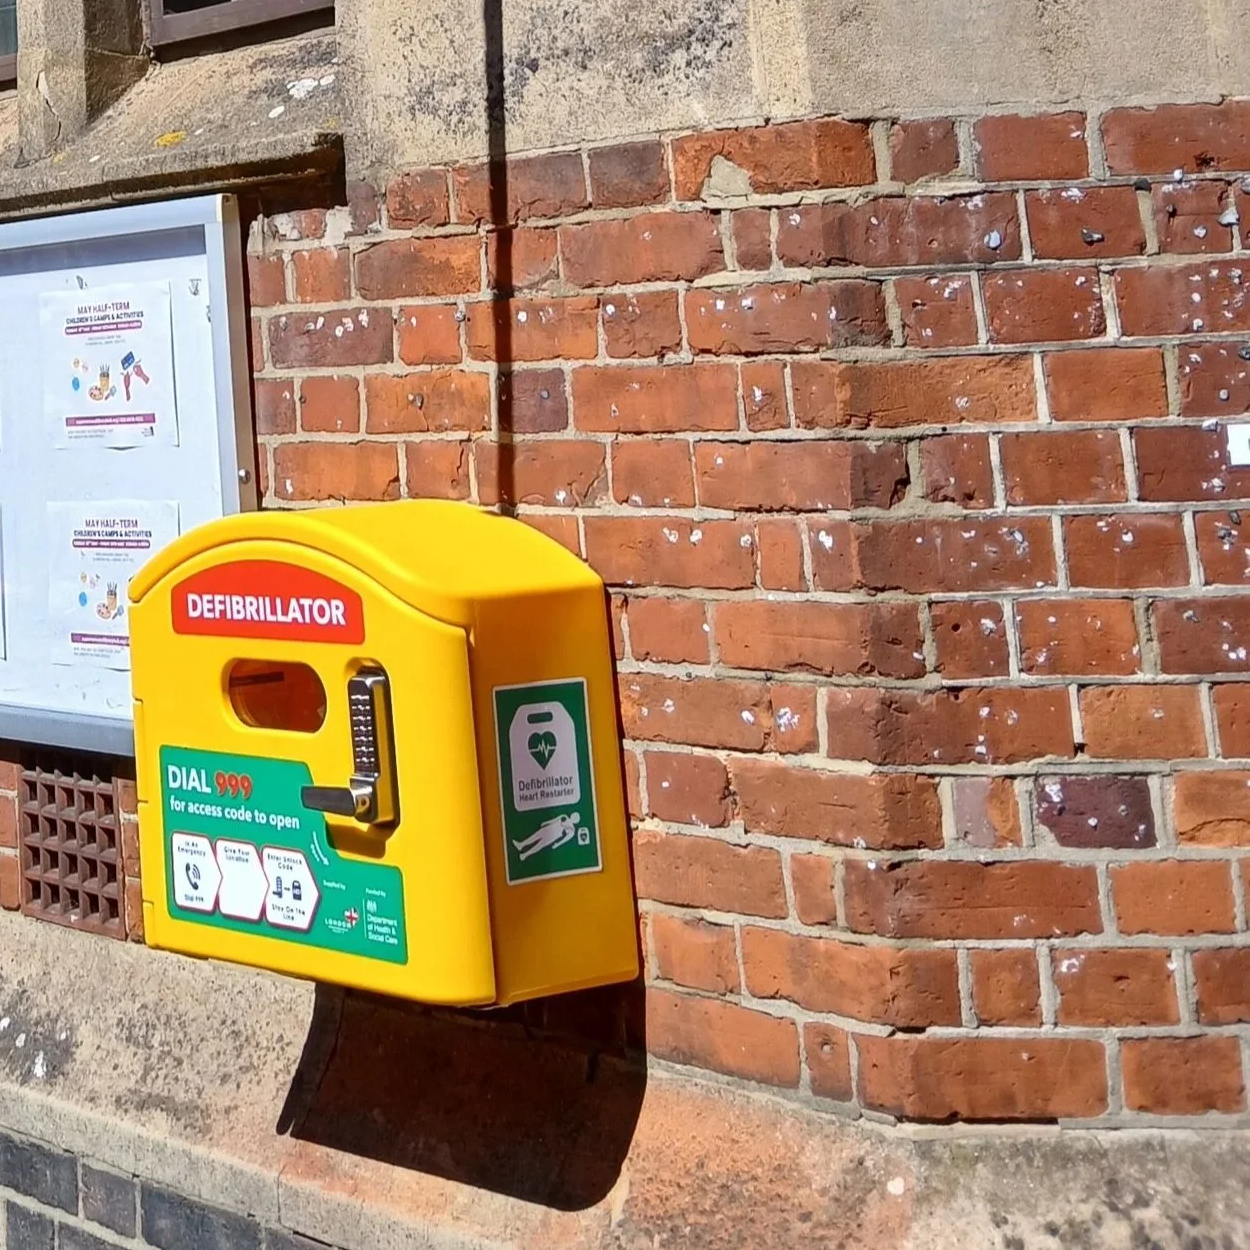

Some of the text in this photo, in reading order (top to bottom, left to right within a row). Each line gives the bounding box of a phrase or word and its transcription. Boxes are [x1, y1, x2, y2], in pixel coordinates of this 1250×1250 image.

[77, 301, 130, 314] MAY HALF-TERM
[85, 519, 138, 528] MAY HALF-TERM
[186, 592, 346, 626] DEFIBRILLATOR
[167, 764, 253, 800] DIAL 999
[518, 775, 573, 792] Defibrillator
[519, 787, 574, 802] Heart Restarter
[170, 795, 300, 830] for access code to open
[178, 846, 206, 857] Emergency
[224, 846, 250, 856] Give Your
[225, 854, 249, 863] Location
[267, 853, 302, 865] Enter Unlock
[278, 862, 293, 871] Code
[367, 914, 397, 927] Department
[373, 924, 391, 934] Health
[368, 932, 398, 945] Social Care
